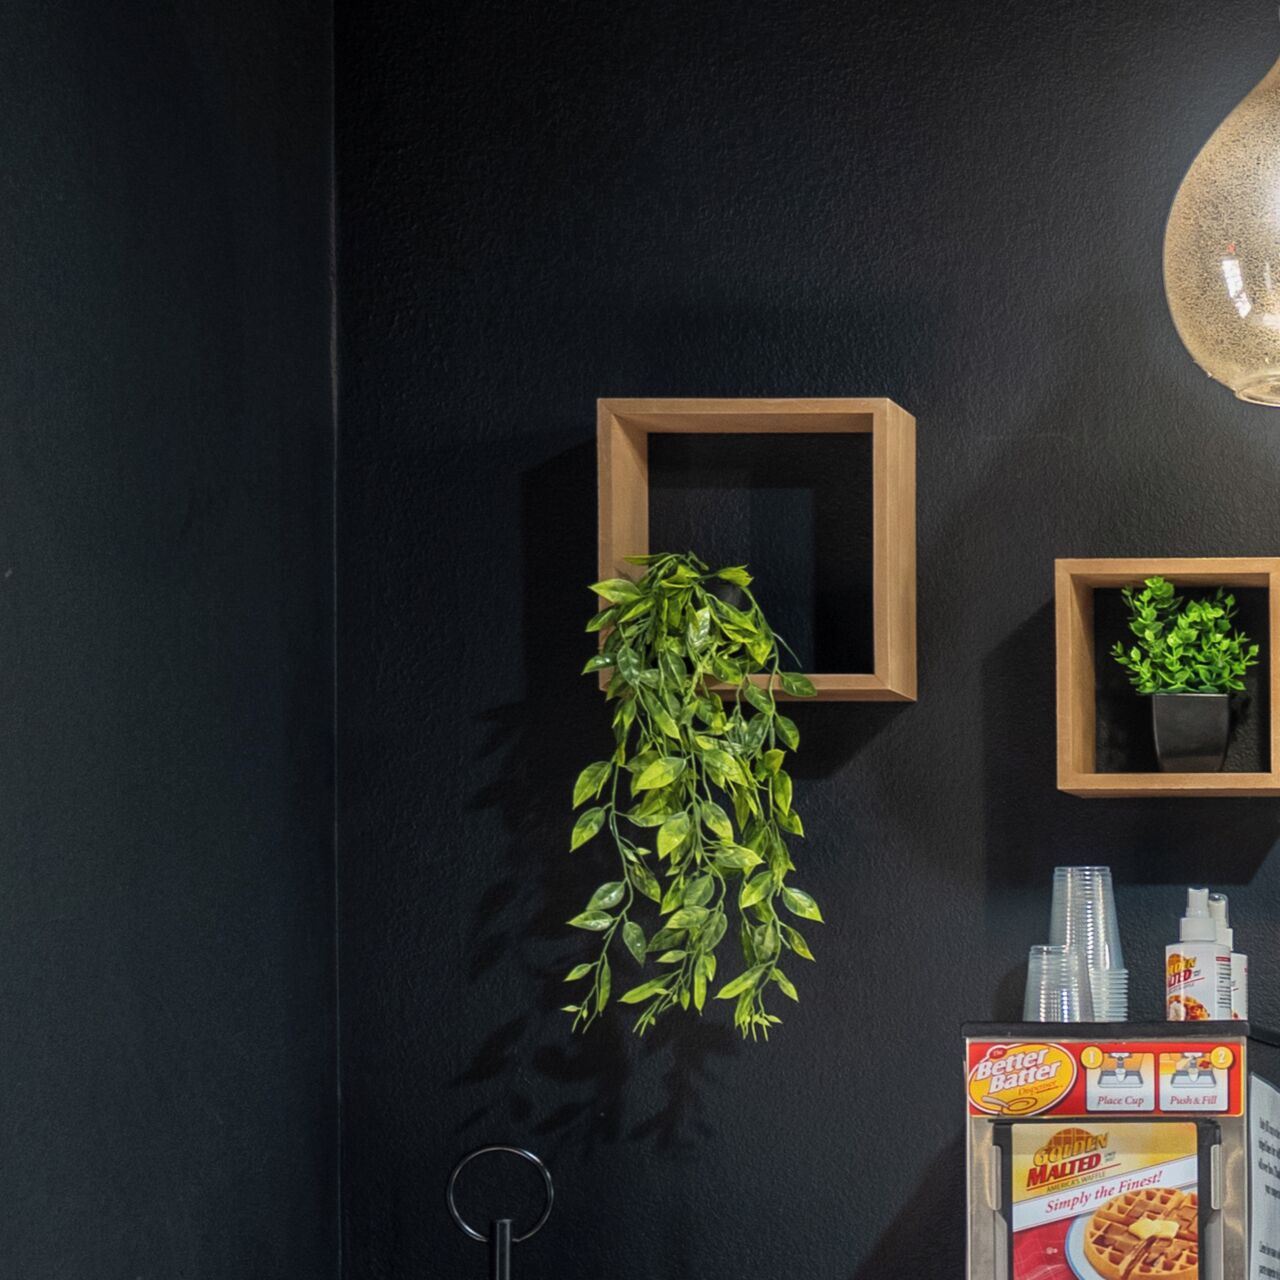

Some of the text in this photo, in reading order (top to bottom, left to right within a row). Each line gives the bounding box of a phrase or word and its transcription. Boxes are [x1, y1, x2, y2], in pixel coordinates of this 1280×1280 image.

[976, 1048, 1049, 1081] Better
[989, 1061, 1062, 1095] Batter
[1098, 1095, 1144, 1106] Place Cup
[1170, 1095, 1193, 1105] Push
[1201, 1095, 1217, 1105] Fill
[1026, 1153, 1102, 1188] MALTED
[1081, 1171, 1106, 1185] WAFFLE
[1045, 1170, 1163, 1214] Simply the Finest!
